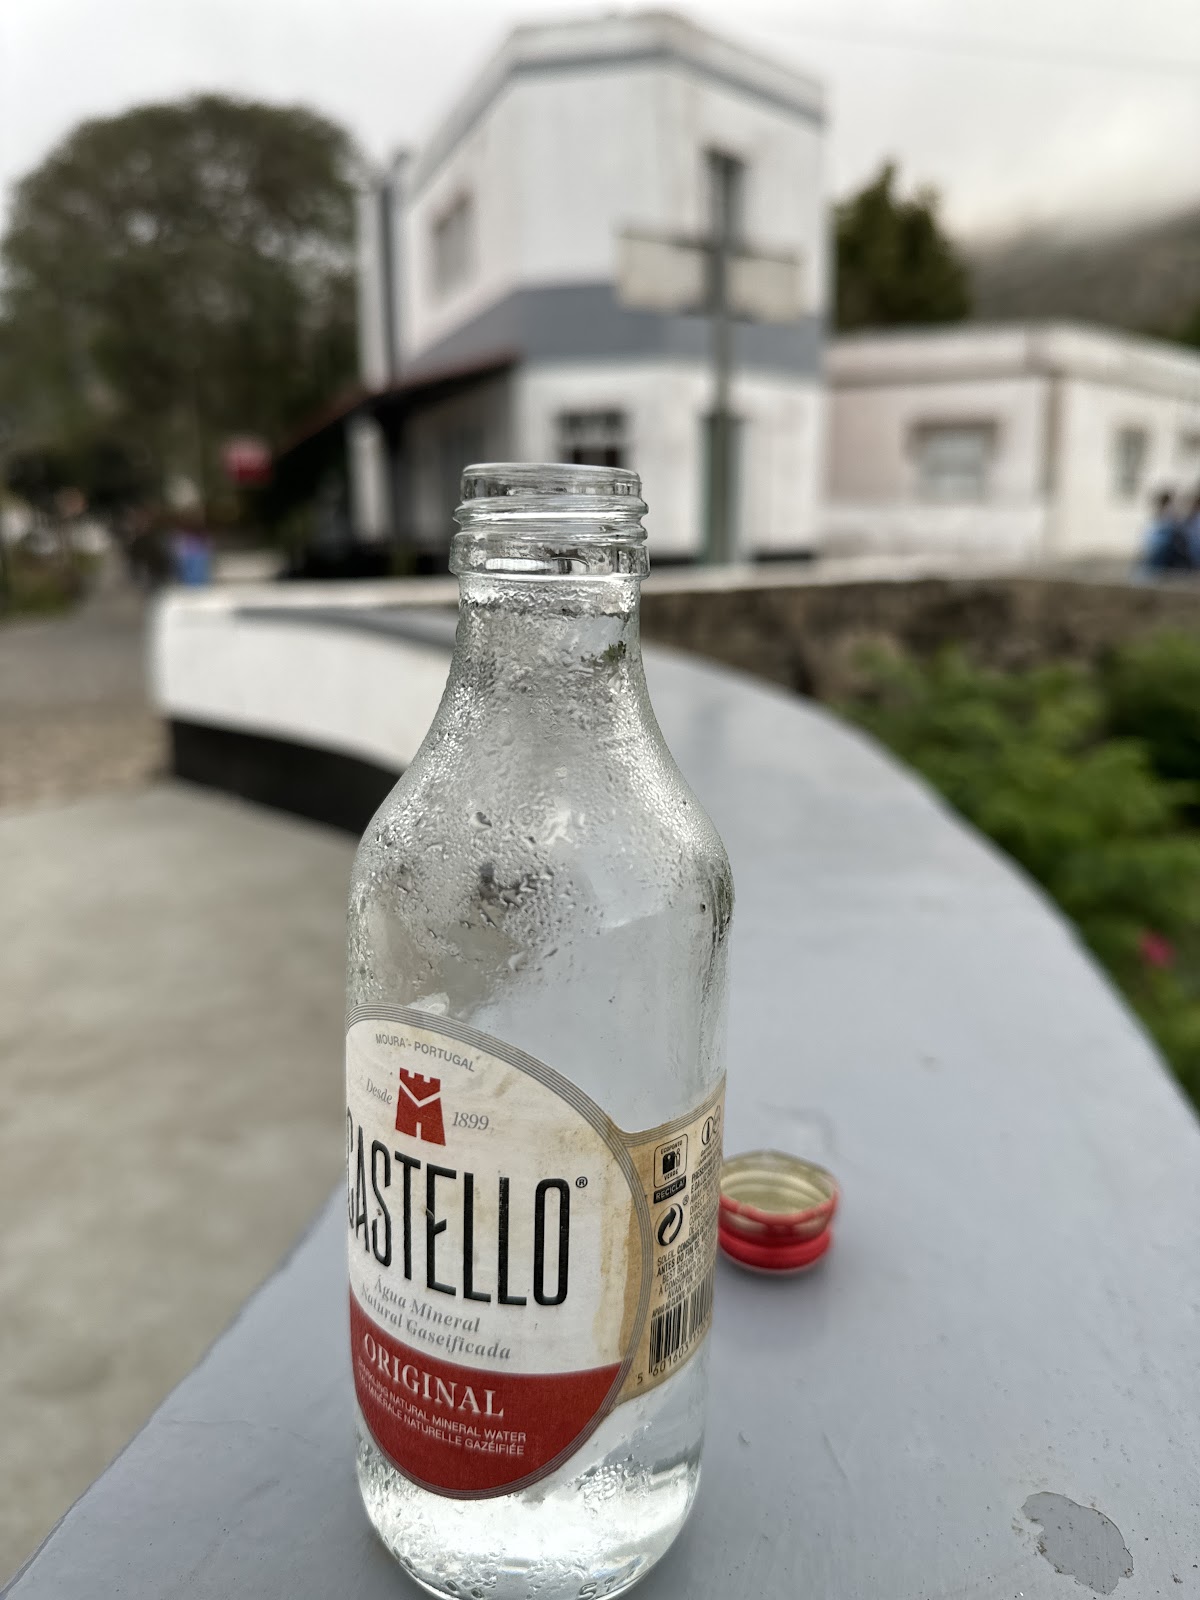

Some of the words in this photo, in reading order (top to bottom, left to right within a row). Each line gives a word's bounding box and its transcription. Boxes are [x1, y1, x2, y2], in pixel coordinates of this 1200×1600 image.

[375, 1033, 406, 1048] MOURA
[414, 1041, 475, 1072] PORTUGAL
[366, 1078, 393, 1105] Desde
[452, 1111, 490, 1131] 1899
[664, 1169, 678, 1180] VERDE
[657, 1259, 675, 1277] ANTES
[362, 1283, 403, 1328] Natural
[406, 1318, 512, 1360] Gaseificada
[374, 1274, 406, 1309] Água
[410, 1298, 480, 1333] Mineral
[364, 1333, 504, 1417] ORIGINAL
[389, 1390, 430, 1422] NATURAL
[432, 1414, 481, 1437] MINERAL
[484, 1428, 526, 1443] WATER
[404, 1414, 462, 1446] NATURELLE
[465, 1438, 525, 1455] GAZÉIFIÉE
